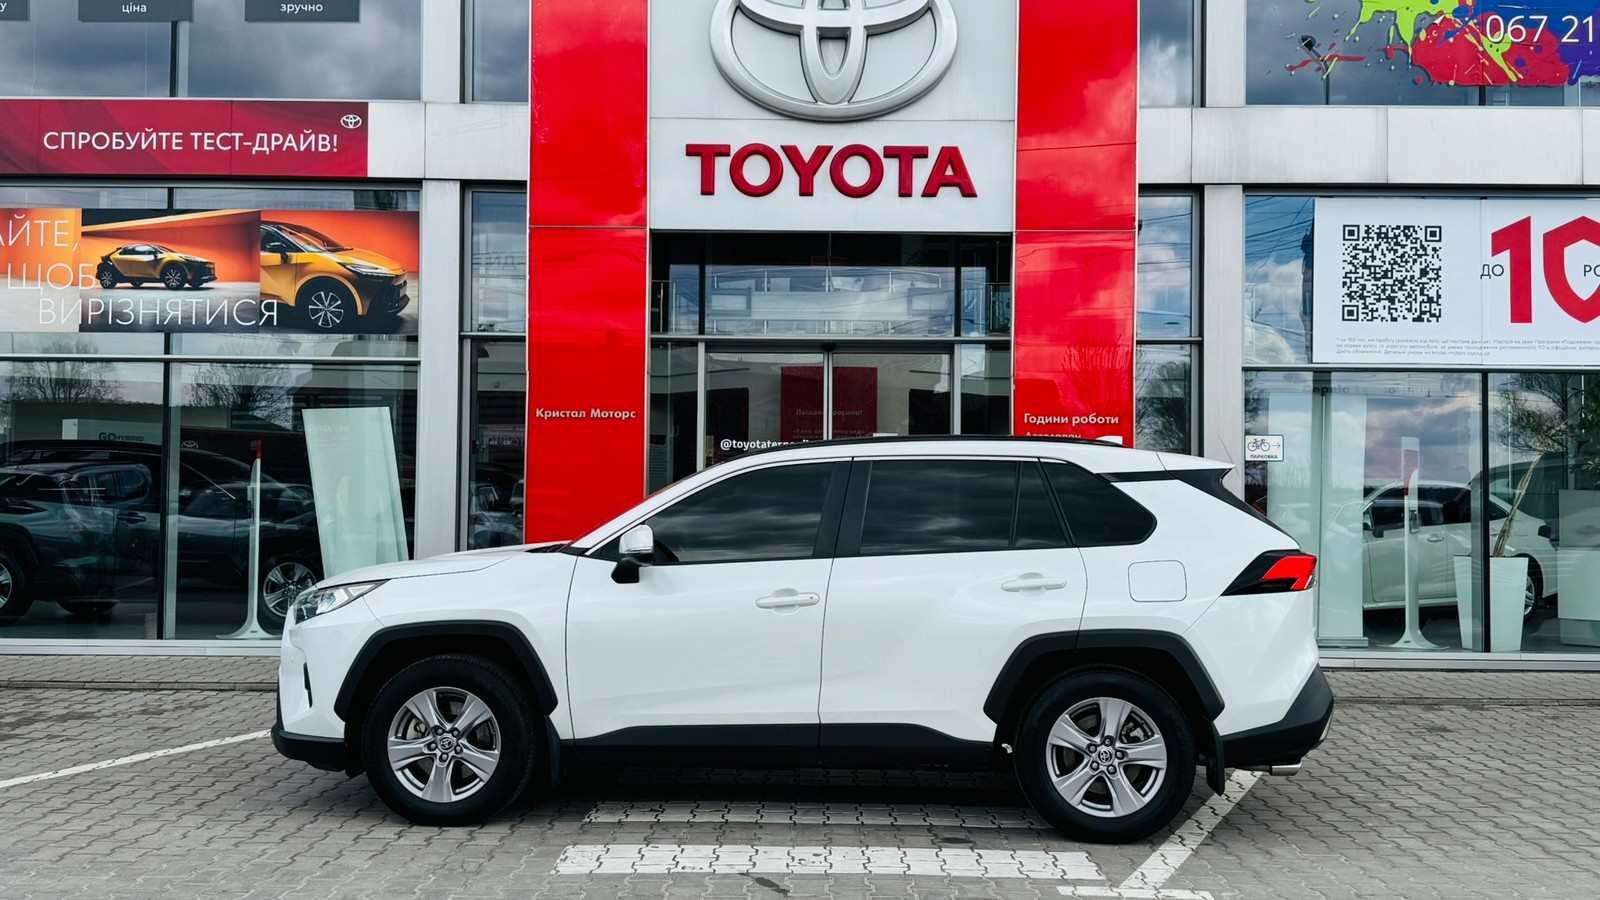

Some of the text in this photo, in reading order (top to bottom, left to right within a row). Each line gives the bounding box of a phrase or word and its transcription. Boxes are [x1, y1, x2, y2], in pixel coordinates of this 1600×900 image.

[121, 3, 147, 14] ціна
[280, 3, 323, 14] зручно
[1486, 15, 1593, 43] 067 21
[43, 127, 338, 155] СПРОБУЙТЕ ТЕСТ-ДРАЙВ!
[685, 143, 977, 198] TOYOTA
[0, 213, 79, 251] ЙТЕ,
[7, 263, 96, 295] ЩОБ
[1480, 264, 1505, 279] ДО
[1491, 215, 1600, 324] 10
[39, 298, 279, 326] ВИРІЗНЯТИСЯ
[535, 408, 636, 420] Кристал Моторс
[1024, 412, 1119, 426] Години роботи
